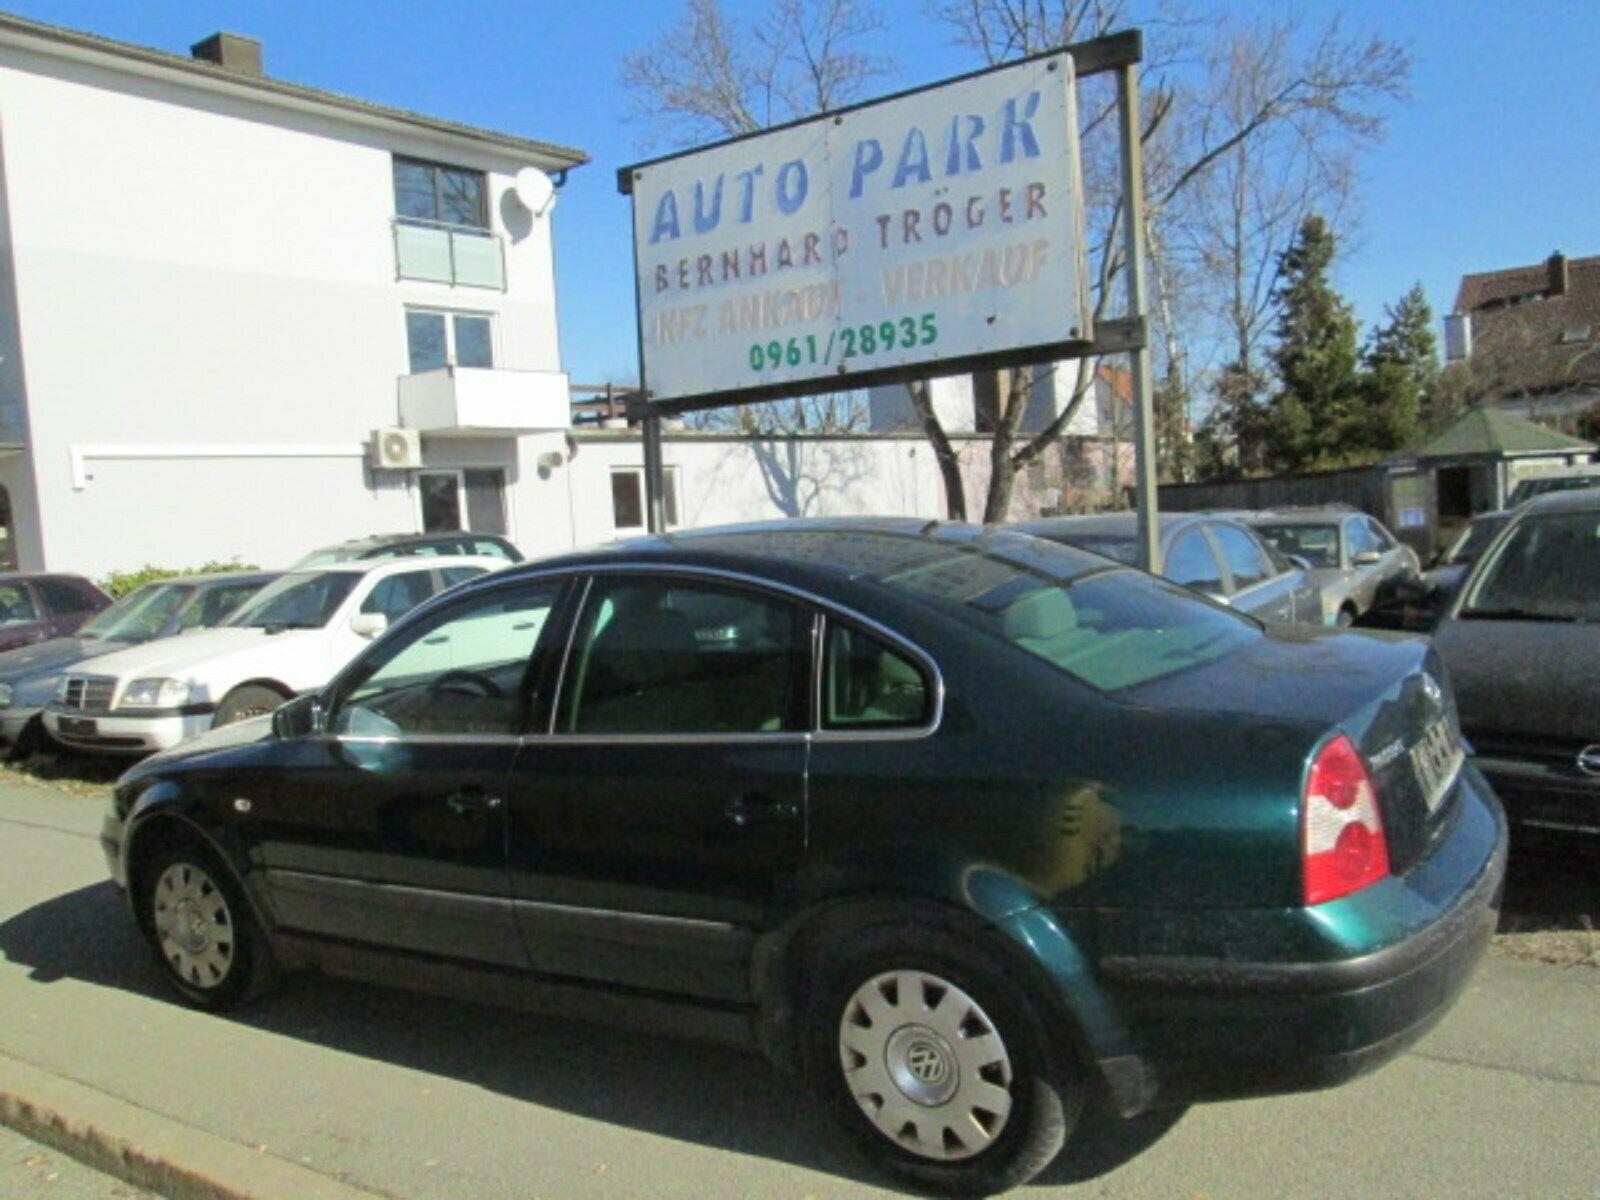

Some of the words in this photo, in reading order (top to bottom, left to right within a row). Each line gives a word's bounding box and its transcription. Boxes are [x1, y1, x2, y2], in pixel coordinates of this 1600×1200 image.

[648, 158, 809, 244] AUTO
[849, 91, 1041, 199] PARK
[655, 228, 849, 293] BERNHARD
[876, 182, 1047, 249] TRÖGER
[656, 303, 708, 345] KFZ
[880, 238, 1050, 304] VERKAUF
[750, 312, 938, 371] 0961/28935
